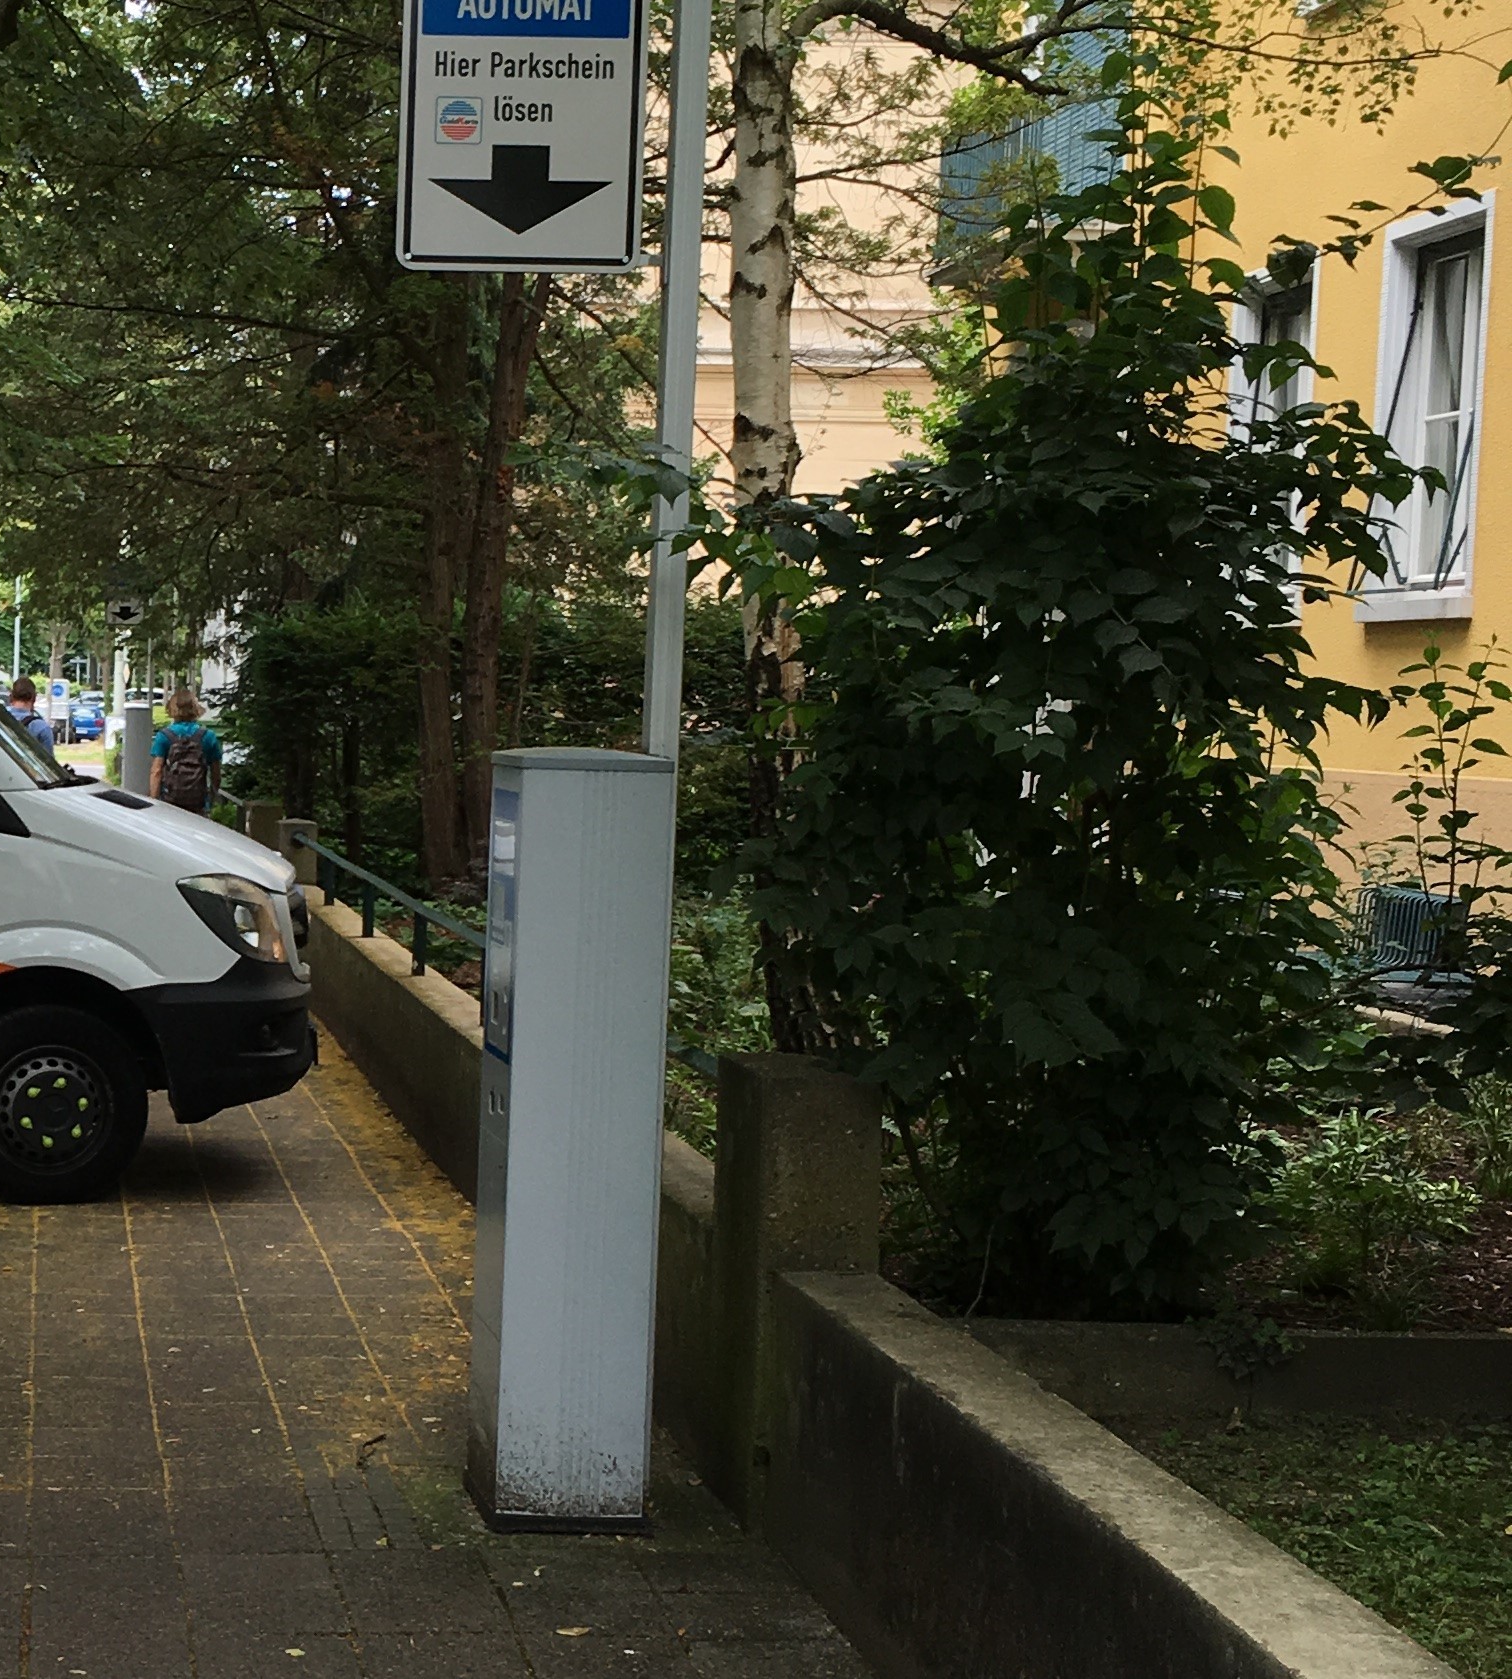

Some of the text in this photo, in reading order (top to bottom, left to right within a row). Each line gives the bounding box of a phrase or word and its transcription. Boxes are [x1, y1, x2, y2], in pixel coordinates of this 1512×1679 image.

[457, 0, 592, 20] AUTOMAT
[434, 51, 615, 79] Hier Parkschein
[494, 96, 553, 122] lösen
